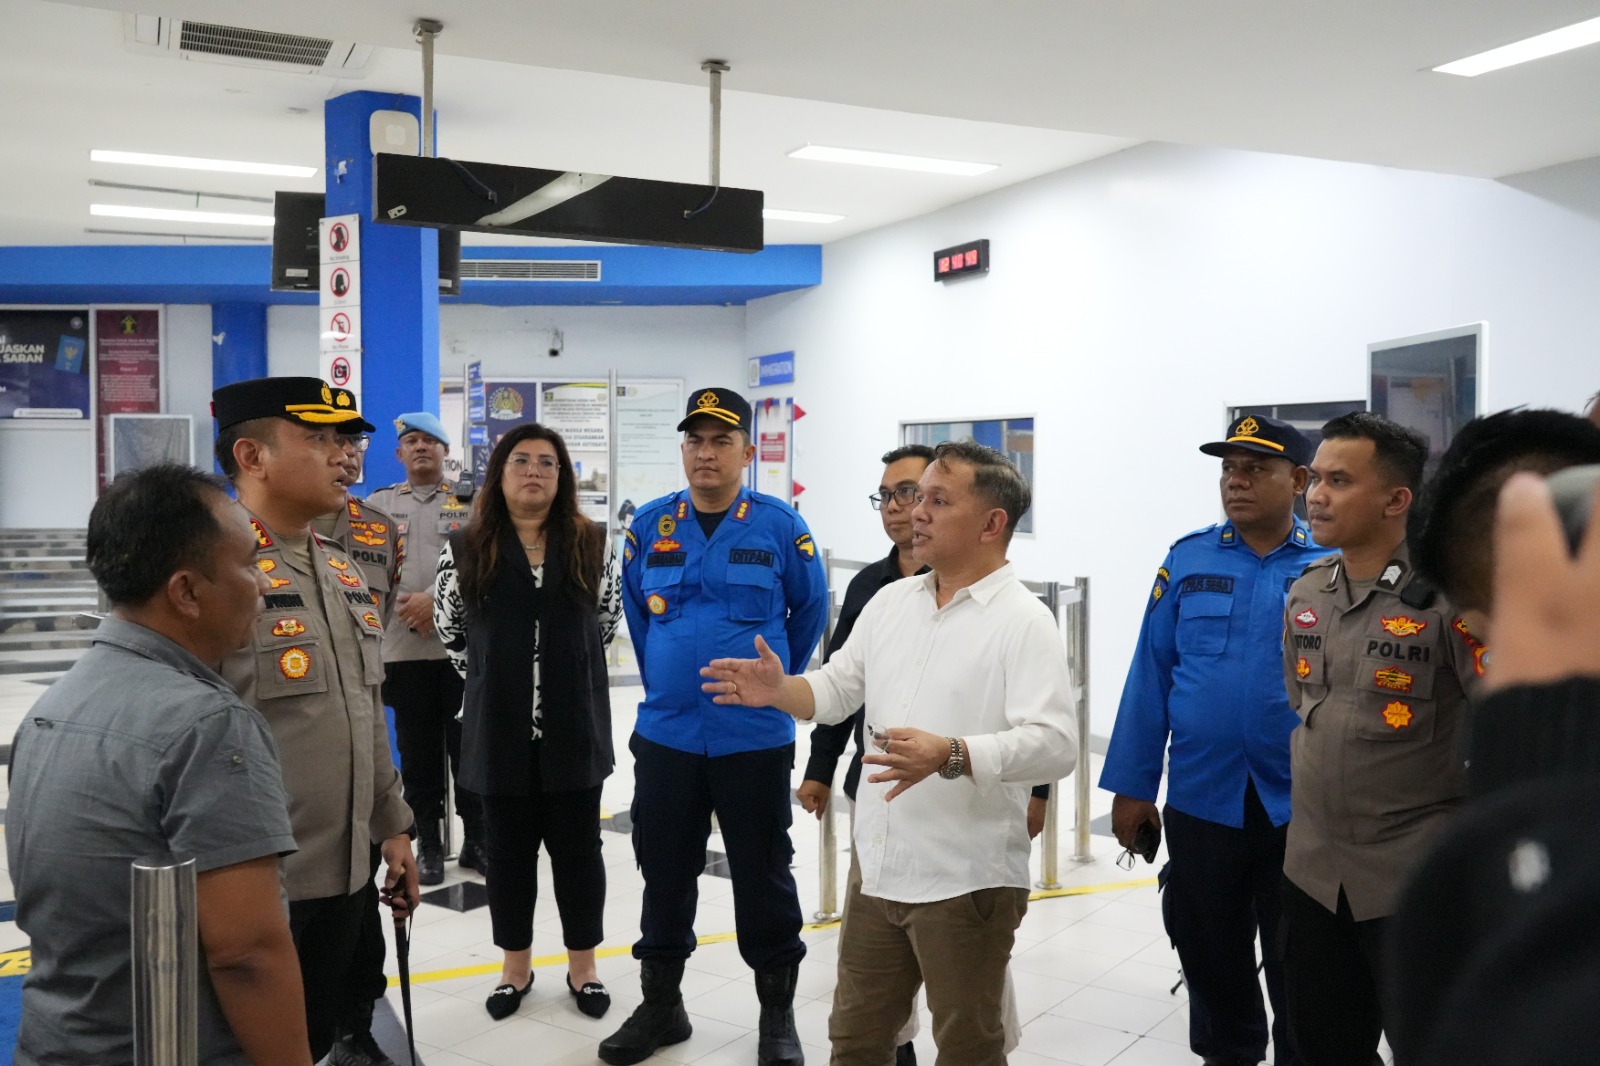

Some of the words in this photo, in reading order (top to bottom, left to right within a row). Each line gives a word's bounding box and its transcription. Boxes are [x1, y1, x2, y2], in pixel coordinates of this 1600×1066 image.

[3, 353, 43, 363] SARAN
[352, 550, 387, 565] POLRI
[1366, 640, 1430, 663] POLRI
